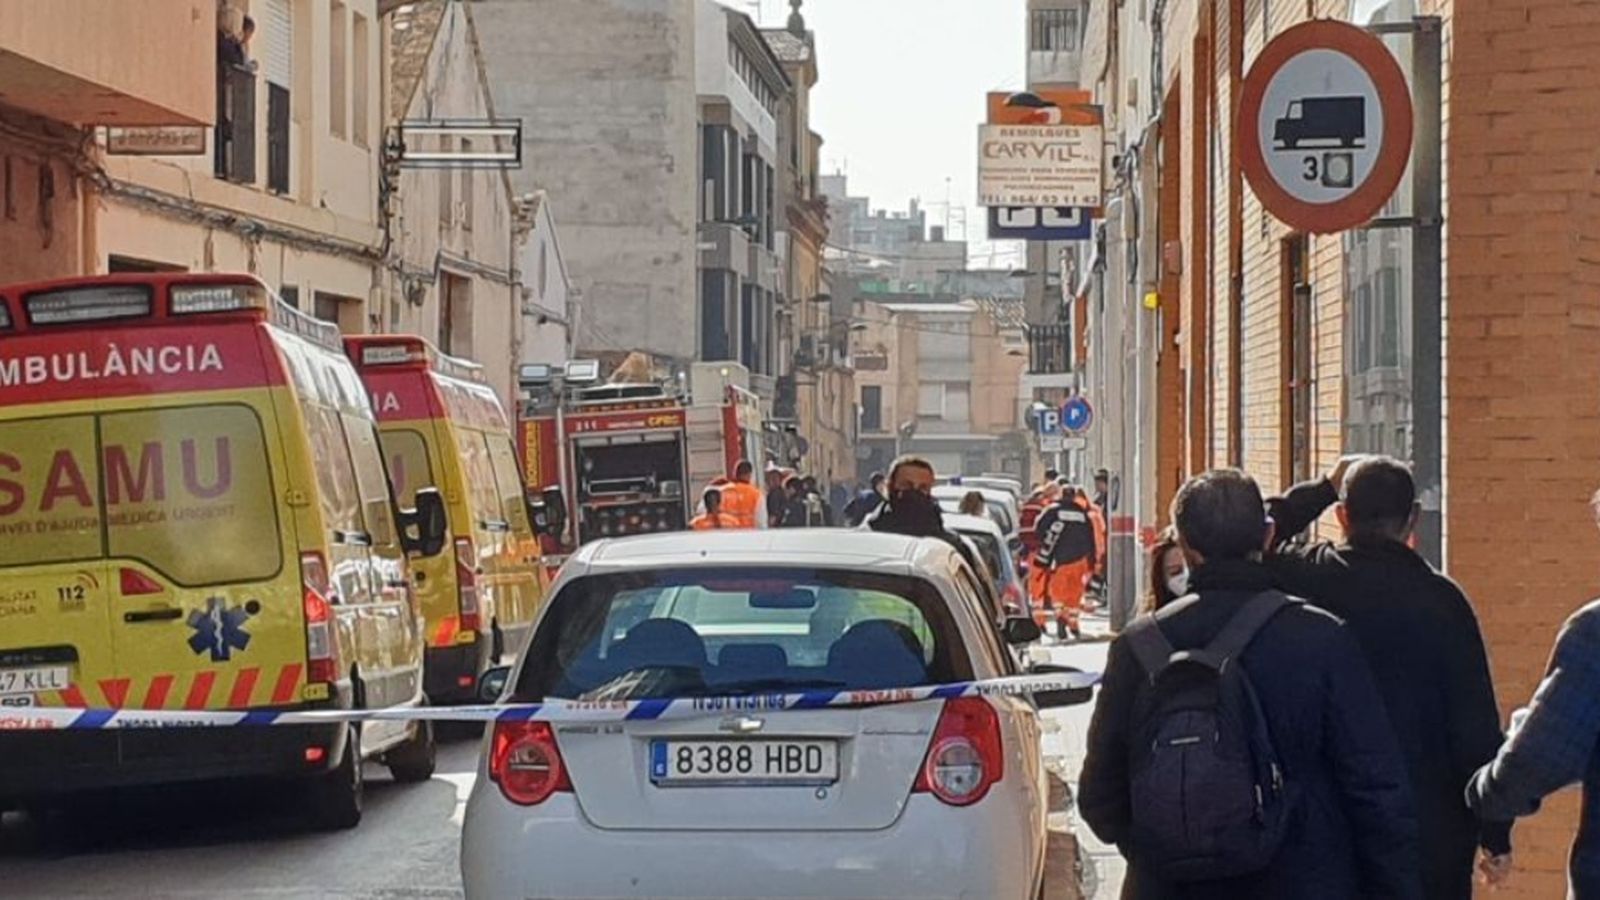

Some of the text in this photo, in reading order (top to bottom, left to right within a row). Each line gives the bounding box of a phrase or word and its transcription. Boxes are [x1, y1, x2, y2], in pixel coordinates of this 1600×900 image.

[1303, 156, 1318, 181] 3
[1045, 411, 1059, 431] P
[57, 585, 84, 601] 112
[24, 671, 61, 690] KLL
[676, 744, 823, 774] 8388 HBD
